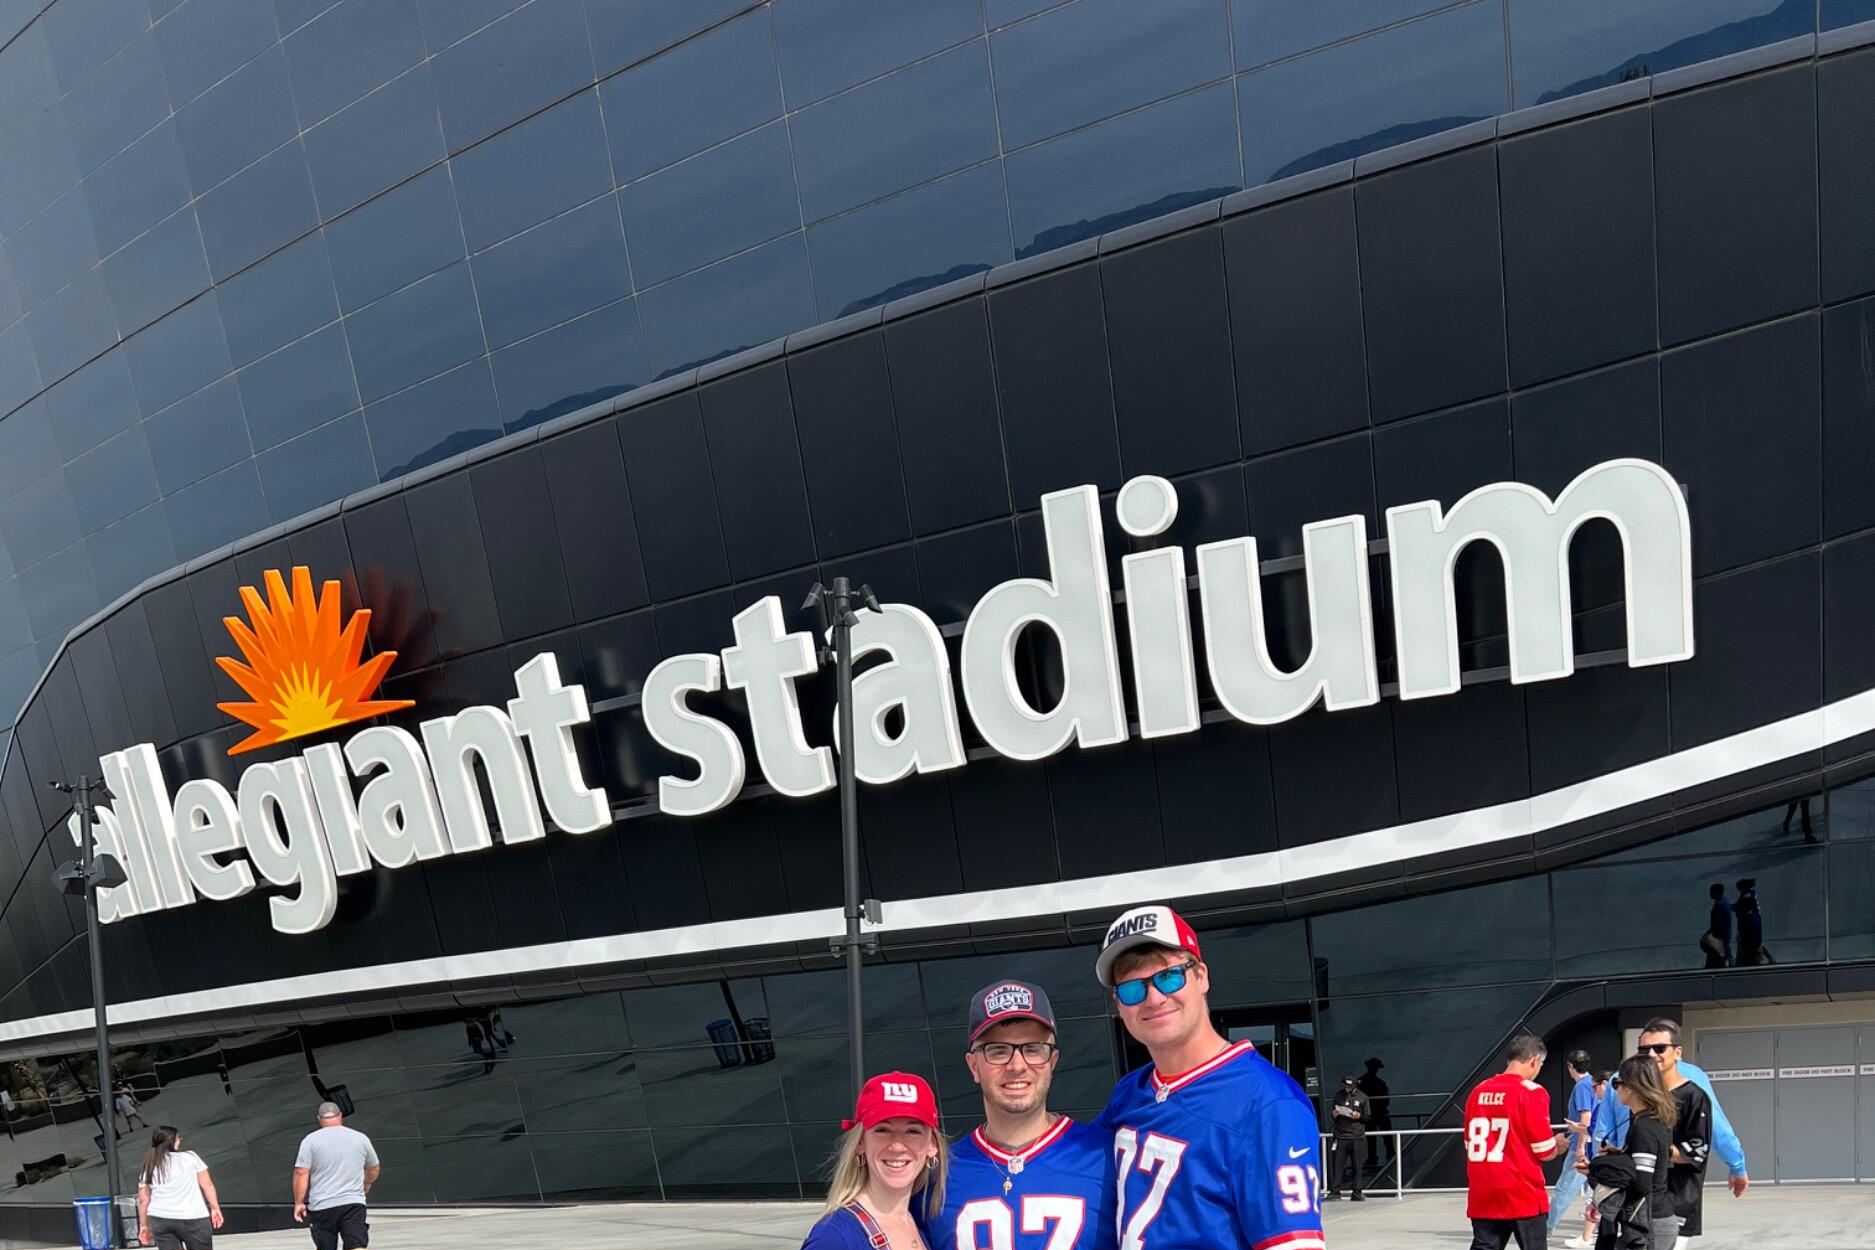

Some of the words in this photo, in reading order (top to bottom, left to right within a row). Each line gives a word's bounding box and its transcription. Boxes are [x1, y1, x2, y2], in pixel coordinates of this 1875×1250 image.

[642, 458, 1695, 815] stadium
[1108, 913, 1158, 946] GIANTS
[1478, 1092, 1506, 1106] KELCE
[1467, 1116, 1510, 1163] 87
